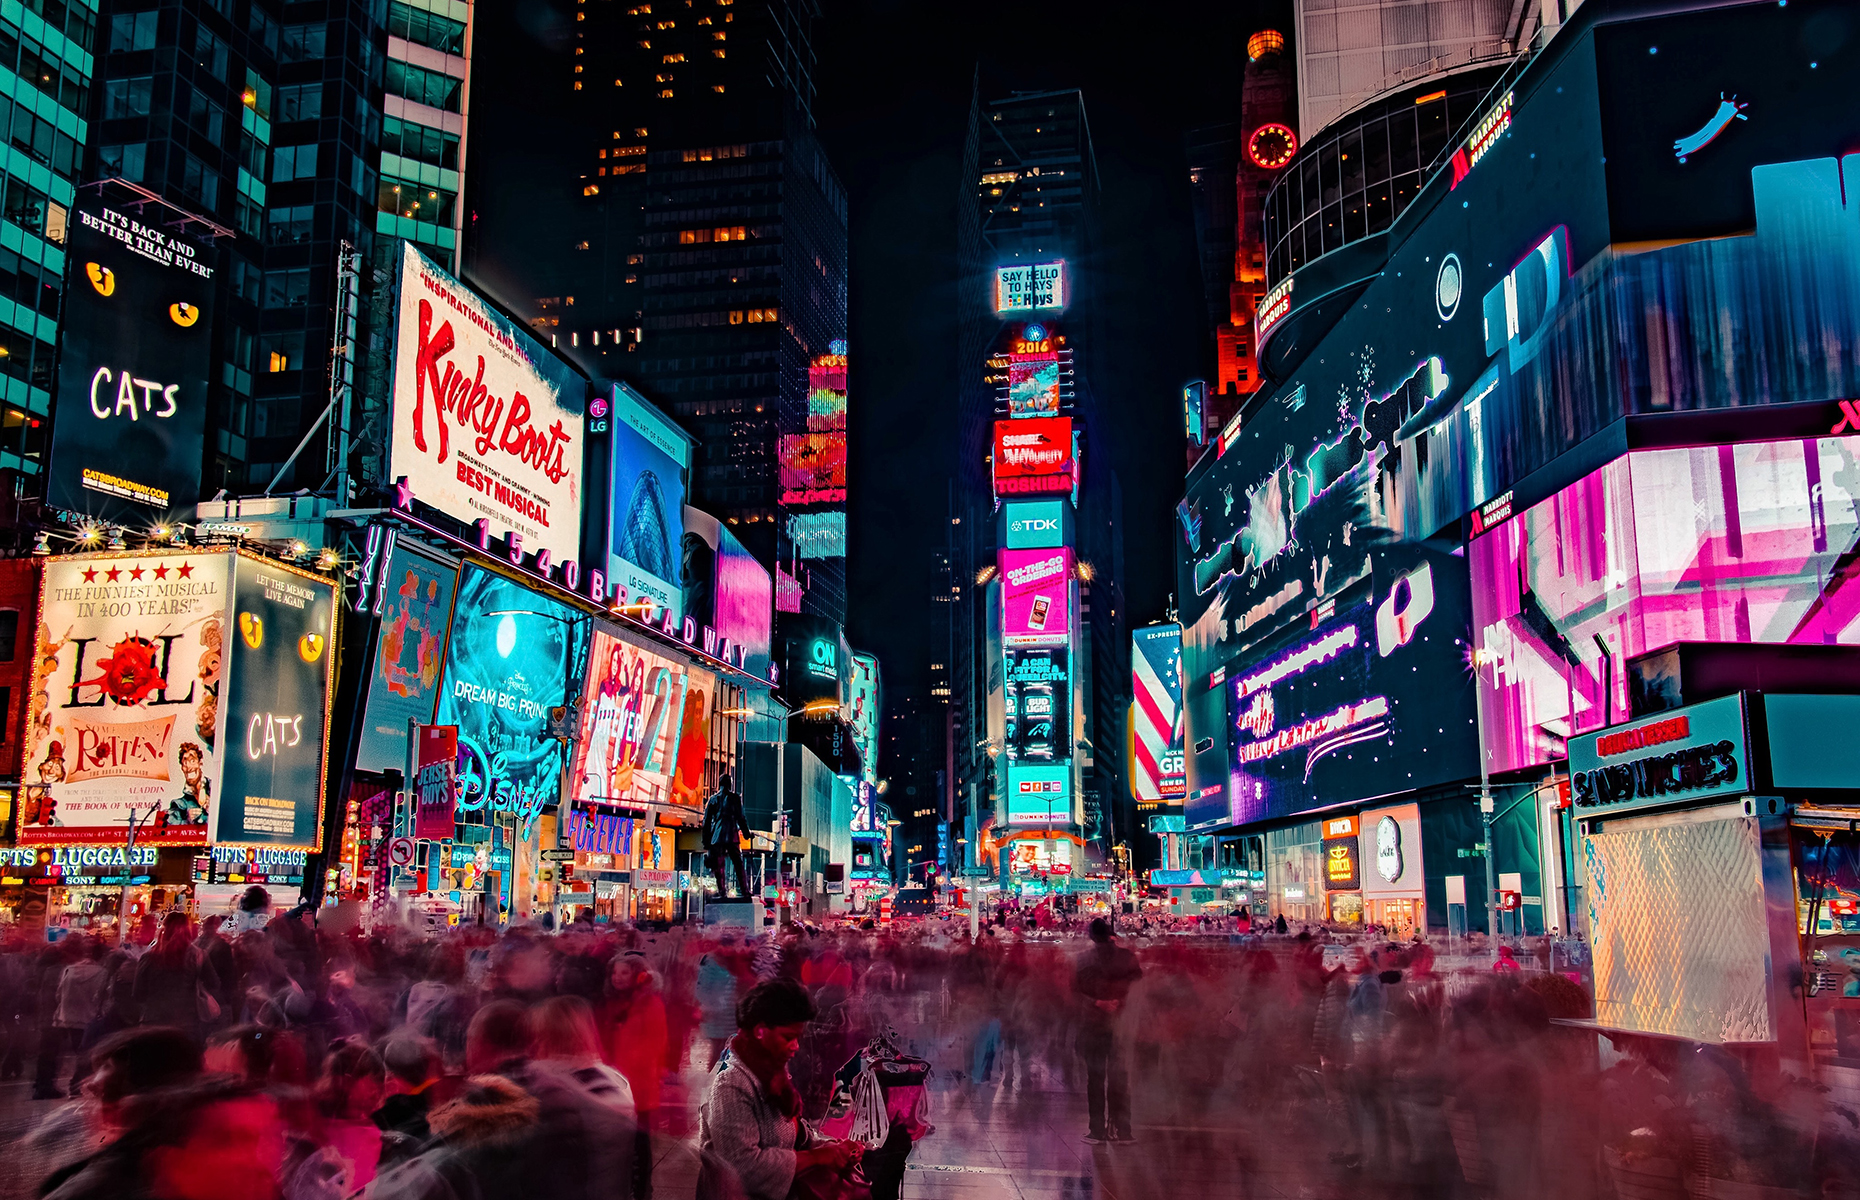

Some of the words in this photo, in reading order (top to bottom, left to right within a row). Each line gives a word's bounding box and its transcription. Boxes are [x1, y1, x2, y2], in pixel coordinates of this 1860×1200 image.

[1469, 90, 1514, 150] MARRIOTT
[1471, 115, 1510, 167] MARQUIS
[102, 207, 129, 228] IT'S
[131, 220, 165, 245] BACK
[167, 238, 196, 258] AND
[136, 236, 173, 262] THAN
[1002, 271, 1022, 282] SAY
[1026, 268, 1058, 280] HELLO
[1008, 282, 1021, 292] TO
[1025, 280, 1053, 291] HAYS
[1259, 278, 1294, 320] MARRIOTT
[1260, 299, 1288, 334] MARQUIS
[496, 330, 515, 351] AND
[1017, 340, 1049, 354] 2016
[1009, 350, 1058, 363] TOSHIBA
[90, 367, 179, 421] CATS
[412, 298, 504, 465] Kinky
[499, 390, 572, 485] Boots
[590, 419, 607, 432] LG
[629, 414, 640, 427] THE
[640, 421, 650, 436] ART
[650, 428, 657, 439] OF
[657, 433, 676, 456] ESSENCE
[82, 468, 169, 501] CATSBROADWAY.COM
[456, 460, 493, 497] BEST
[494, 481, 550, 528] MUSICAL
[997, 475, 1073, 493] TOSHIBA
[1483, 490, 1514, 516] MARRIOTT
[1021, 519, 1058, 531] TDK
[1484, 504, 1511, 527] MARQUIS
[206, 523, 245, 533] LAMAR
[1007, 555, 1063, 579] ON-THE-GO
[1012, 564, 1063, 586] ORDERING
[55, 588, 82, 602] THE
[85, 585, 153, 600] FUNNIEST
[156, 582, 218, 597] MUSICAL
[256, 573, 270, 586] LET
[270, 579, 285, 592] THE
[286, 583, 315, 601] MEMORY
[629, 574, 637, 588] LG
[637, 579, 668, 604] SIGNATURE
[76, 602, 97, 618] IN
[100, 602, 131, 617] 400
[265, 588, 281, 603] LIVE
[282, 592, 305, 610] AGAIN
[591, 568, 748, 670] BROADWAY
[813, 640, 836, 667] ON
[1022, 658, 1029, 667] A
[1030, 657, 1051, 666] CAN
[808, 662, 824, 672] smart
[1014, 666, 1030, 674] FIT
[1030, 665, 1051, 674] FOR
[1051, 664, 1060, 673] A
[1008, 673, 1041, 684] QUEEN
[454, 680, 496, 706] DREAM
[497, 692, 518, 714] BIG,
[1026, 705, 1050, 713] LIGHT
[643, 667, 689, 777] 21
[247, 712, 303, 760] CATS
[832, 725, 840, 756] 1500
[1596, 715, 1690, 758] DELICATESSEN
[1573, 739, 1738, 808] SANDWICHES
[129, 786, 165, 794] ALADDIN
[421, 781, 449, 805] BOYS
[1161, 785, 1185, 793] SUNDAY
[65, 803, 83, 811] THE
[84, 802, 108, 811] BOOK
[110, 802, 120, 810] OF
[52, 847, 158, 867] LUGGAGE
[211, 846, 247, 863] GIFTS
[255, 849, 307, 867] LUGGAGE
[61, 865, 80, 877] NY
[65, 876, 96, 885] SONY
[268, 875, 288, 883] SONY
[1190, 889, 1214, 900] 1515
